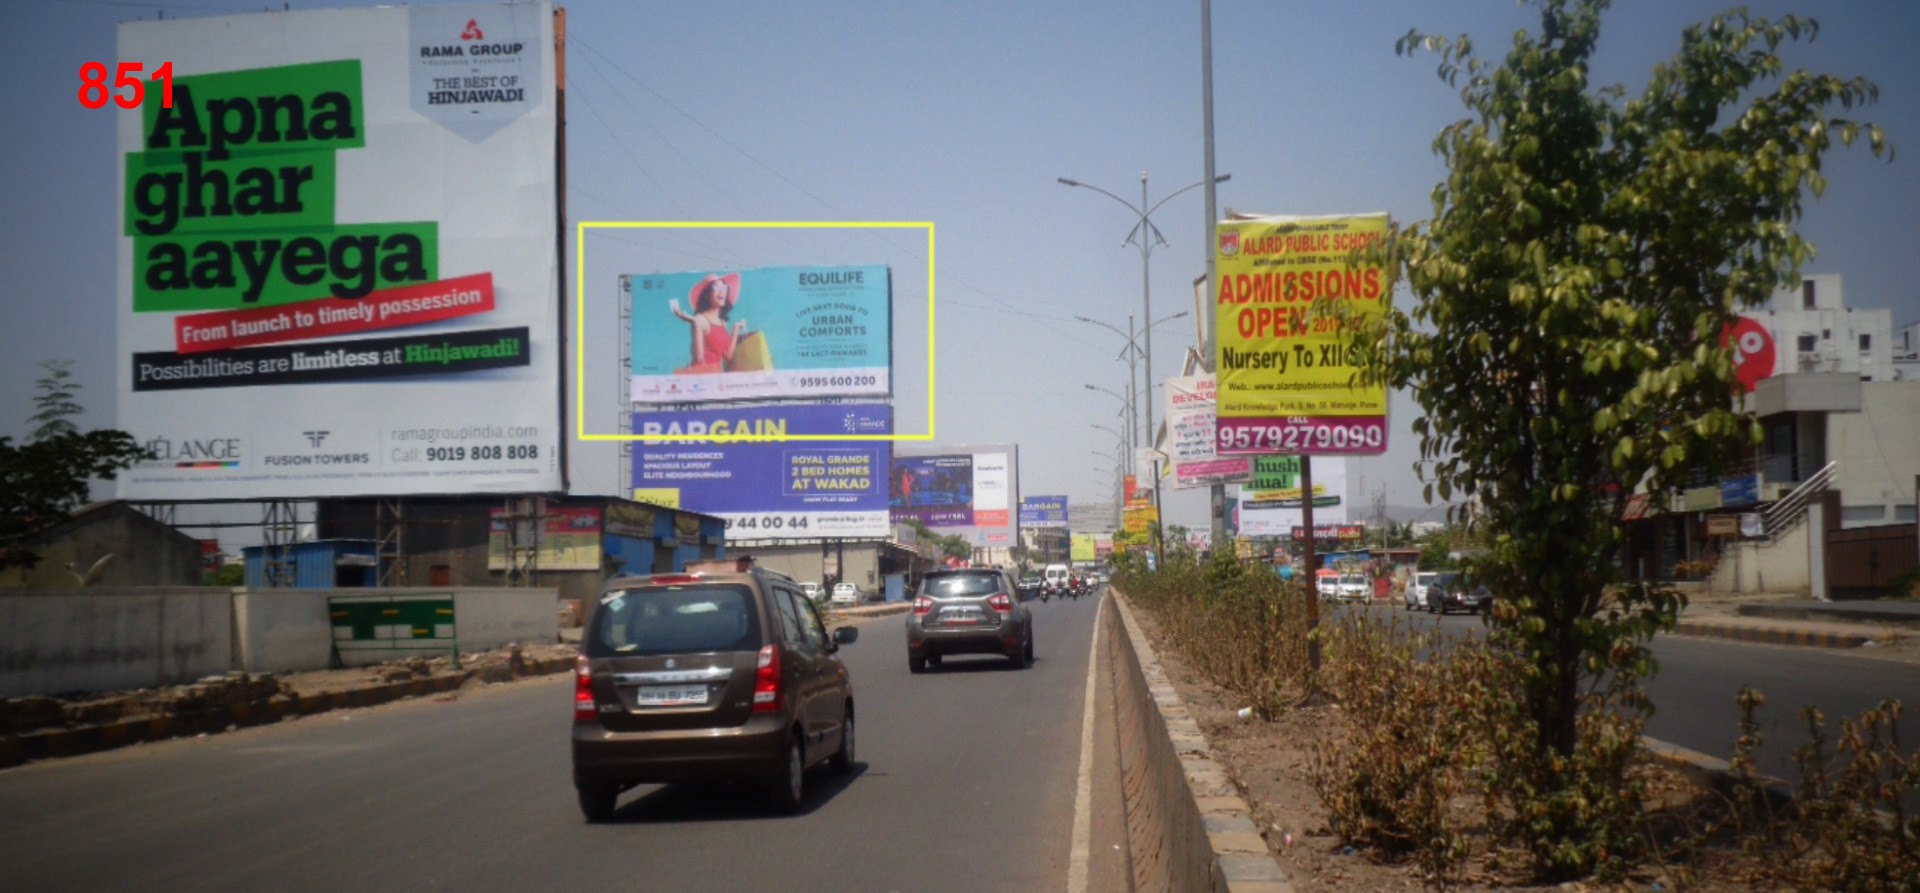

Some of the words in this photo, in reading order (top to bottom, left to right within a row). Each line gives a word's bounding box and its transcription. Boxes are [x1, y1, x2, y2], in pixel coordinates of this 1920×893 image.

[421, 45, 464, 58] RAMA
[470, 43, 523, 56] GROUP
[433, 77, 461, 90] THE
[464, 76, 498, 89] BEST
[500, 75, 519, 88] OF
[428, 88, 524, 104] HINJAWADI
[147, 84, 356, 160] Apna
[133, 152, 314, 236] ghar
[1242, 236, 1283, 256] ALARD
[1286, 234, 1330, 253] PUBLIC
[1333, 231, 1384, 251] SCHOOL
[145, 233, 427, 302] aayega
[799, 271, 864, 285] EQUILIFE
[1217, 267, 1380, 305] ADMISSIONS
[182, 326, 228, 343] From
[232, 313, 291, 337] launch
[295, 311, 314, 327] to
[319, 301, 374, 325] timely
[380, 289, 482, 320] possession
[812, 315, 853, 326] URBAN
[1237, 306, 1308, 339] OPEN
[799, 326, 867, 338] COMFORTS
[139, 357, 254, 382] Possibilities
[258, 358, 289, 374] are
[291, 348, 380, 371] limitless
[382, 347, 402, 364] at
[404, 337, 520, 365] Hinjawadi!
[1222, 346, 1289, 374] Nursery
[1293, 344, 1314, 368] To
[1319, 343, 1343, 368] XII
[800, 376, 829, 388] 9595
[830, 376, 852, 386] 600
[854, 375, 876, 386] 200
[1287, 416, 1309, 424] CALL
[391, 424, 538, 443] ramagroupindia.com
[643, 418, 787, 445] BARGAIN
[1219, 424, 1382, 449] 9579279090
[264, 455, 311, 466] FUSION
[315, 453, 369, 465] TOWERS
[391, 447, 423, 463] Call:
[426, 446, 466, 462] 9019
[470, 445, 502, 460] 808
[506, 445, 539, 460] 808
[792, 455, 824, 464] ROYAL
[827, 455, 870, 464] GRANDE
[682, 462, 712, 470] LAYOUT
[792, 467, 799, 477] 2
[801, 466, 825, 476] BED
[828, 466, 870, 476] HOMES
[791, 478, 810, 490] AT
[814, 477, 870, 490] WAKAD
[1022, 502, 1061, 511] BARGAIN
[737, 516, 757, 530] 44
[761, 516, 783, 529] 00
[787, 516, 809, 529] 44
